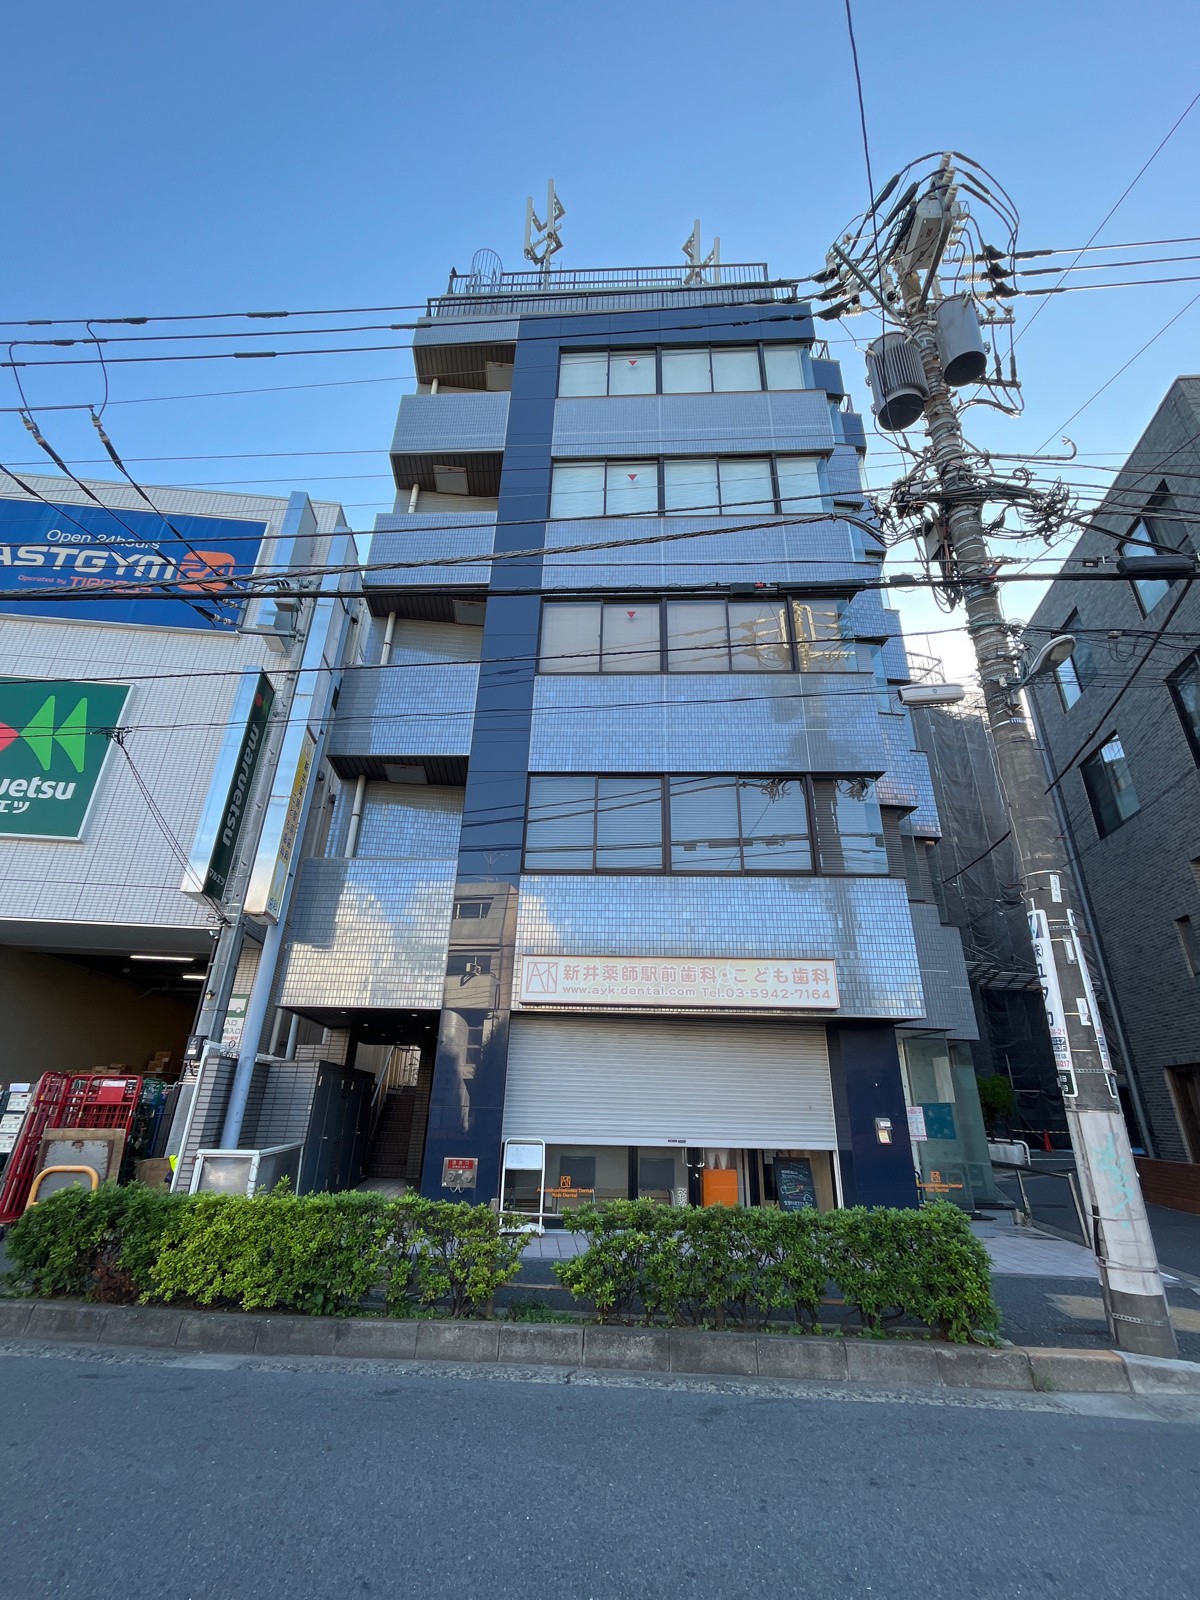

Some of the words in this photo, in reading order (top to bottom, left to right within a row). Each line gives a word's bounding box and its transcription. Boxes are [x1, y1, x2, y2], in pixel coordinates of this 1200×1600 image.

[47, 529, 91, 543] Open
[96, 534, 161, 549] 24hours
[18, 574, 54, 583] Operated
[57, 577, 67, 585] by
[223, 723, 260, 847] maruetsu
[562, 985, 696, 998] www.ayk-dental.com
[702, 987, 831, 1000] Tel.03-5942-7164
